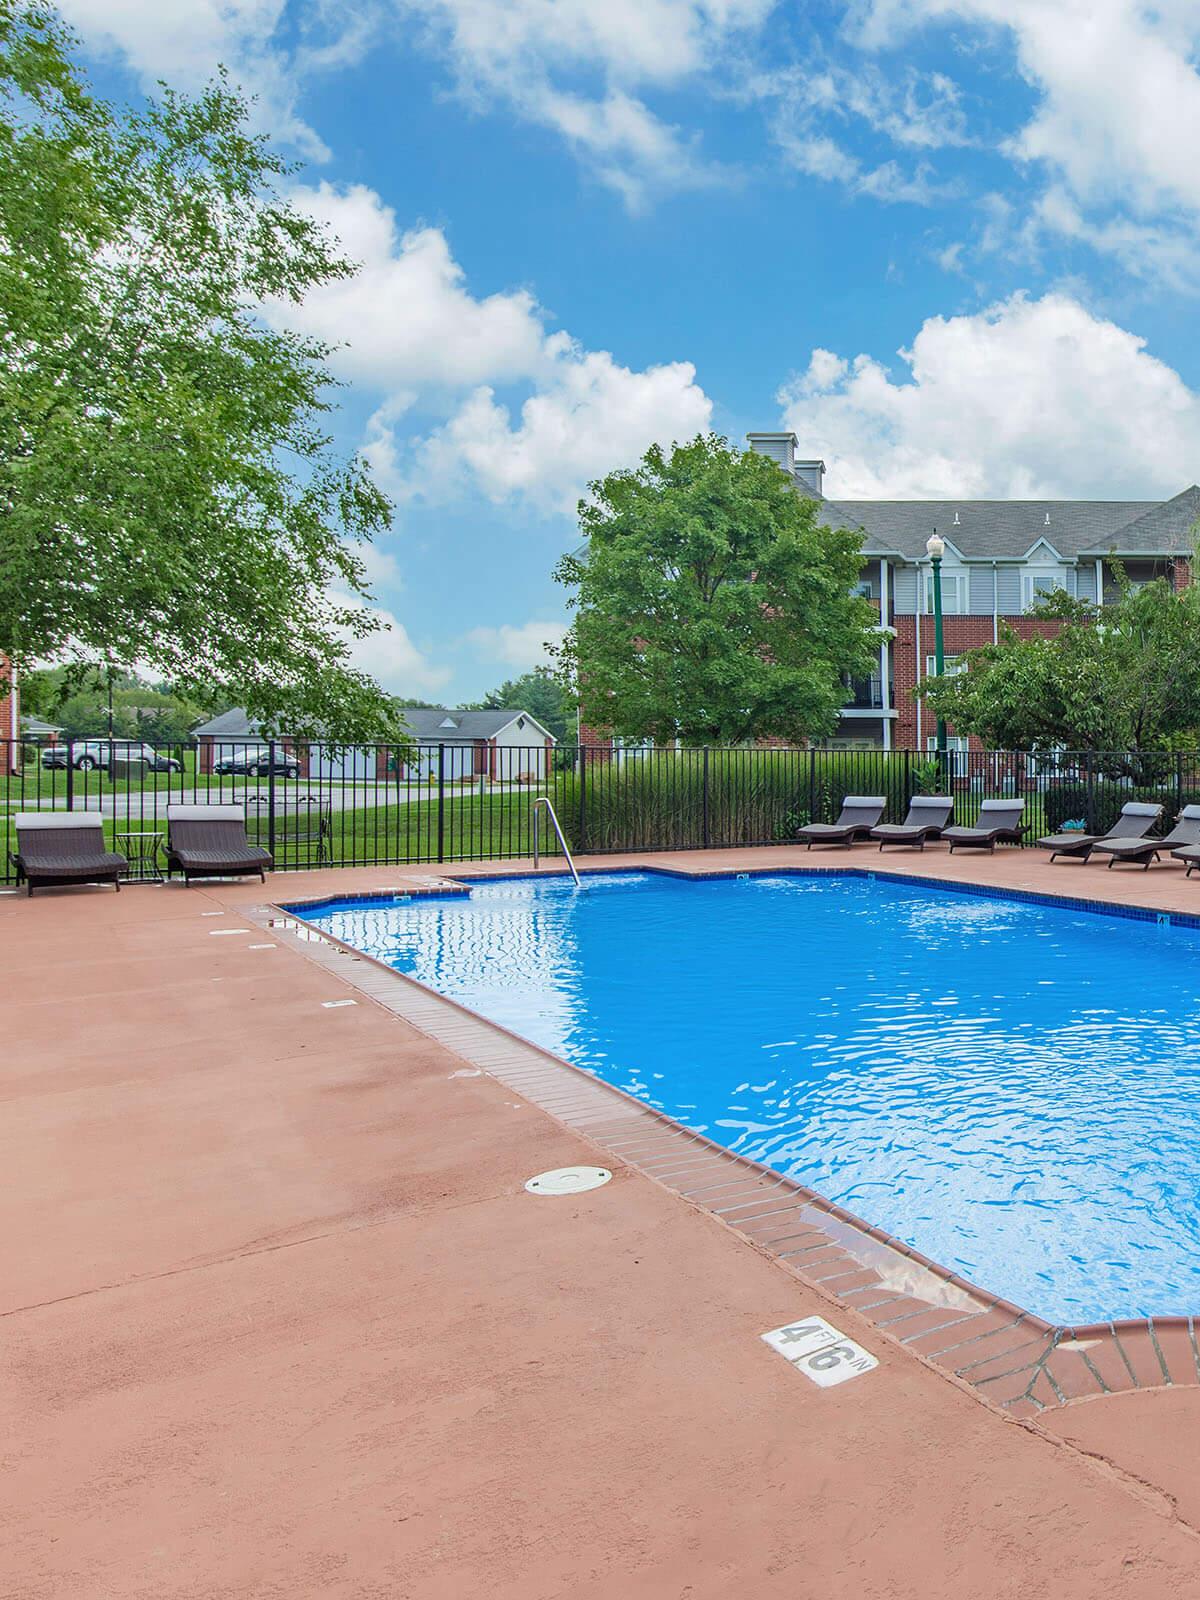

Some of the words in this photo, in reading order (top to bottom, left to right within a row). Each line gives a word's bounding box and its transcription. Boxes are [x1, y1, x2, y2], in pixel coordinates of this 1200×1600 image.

[779, 1325, 824, 1344] 4
[813, 1331, 836, 1342] FT
[808, 1346, 856, 1371] 6
[849, 1358, 873, 1371] IN
